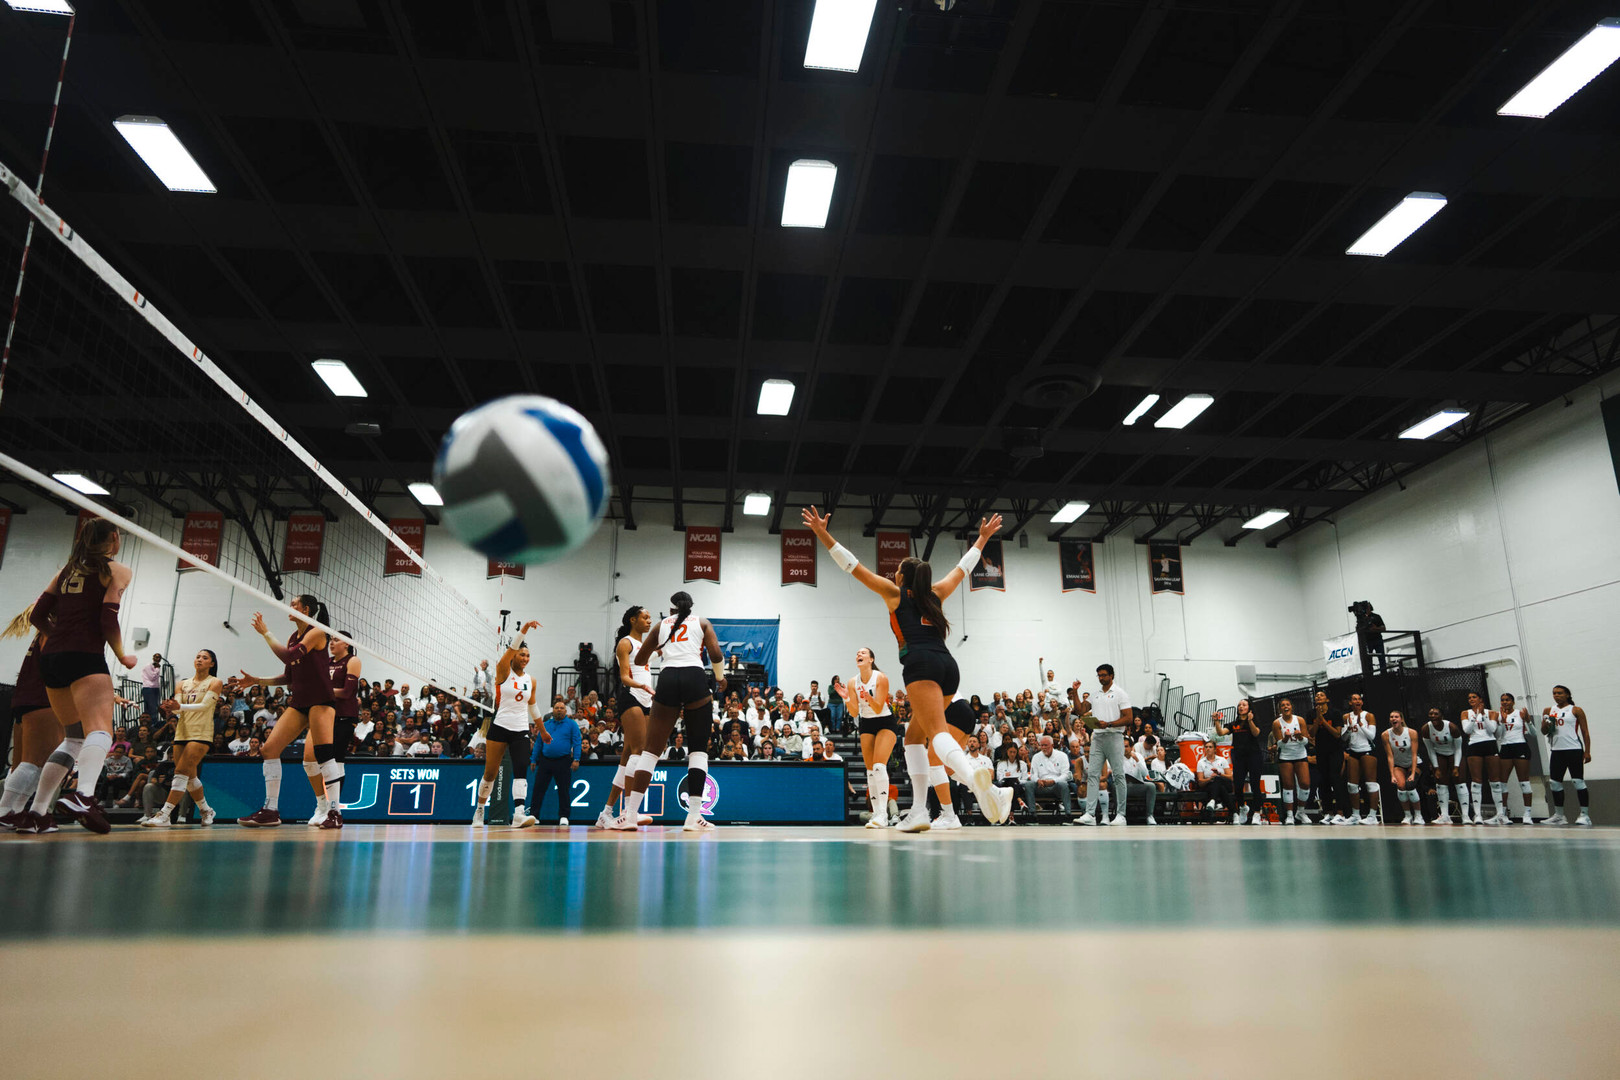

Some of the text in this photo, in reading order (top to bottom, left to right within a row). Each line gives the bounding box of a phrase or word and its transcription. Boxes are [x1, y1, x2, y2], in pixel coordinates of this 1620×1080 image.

[188, 520, 218, 529] NCAA
[291, 523, 320, 532] NCAA
[690, 533, 717, 542] NCAA
[785, 538, 812, 546] NCAA
[880, 540, 907, 549] NCAA
[191, 553, 208, 561] 010
[1328, 646, 1354, 660] ACCN
[187, 695, 196, 704] 17
[515, 690, 524, 702] 6
[1477, 722, 1484, 730] 11
[1196, 746, 1204, 755] G
[1222, 749, 1230, 757] G
[390, 768, 439, 780] SETS WON
[650, 770, 667, 781] ON
[410, 784, 421, 809] 1
[466, 778, 491, 807] 1
